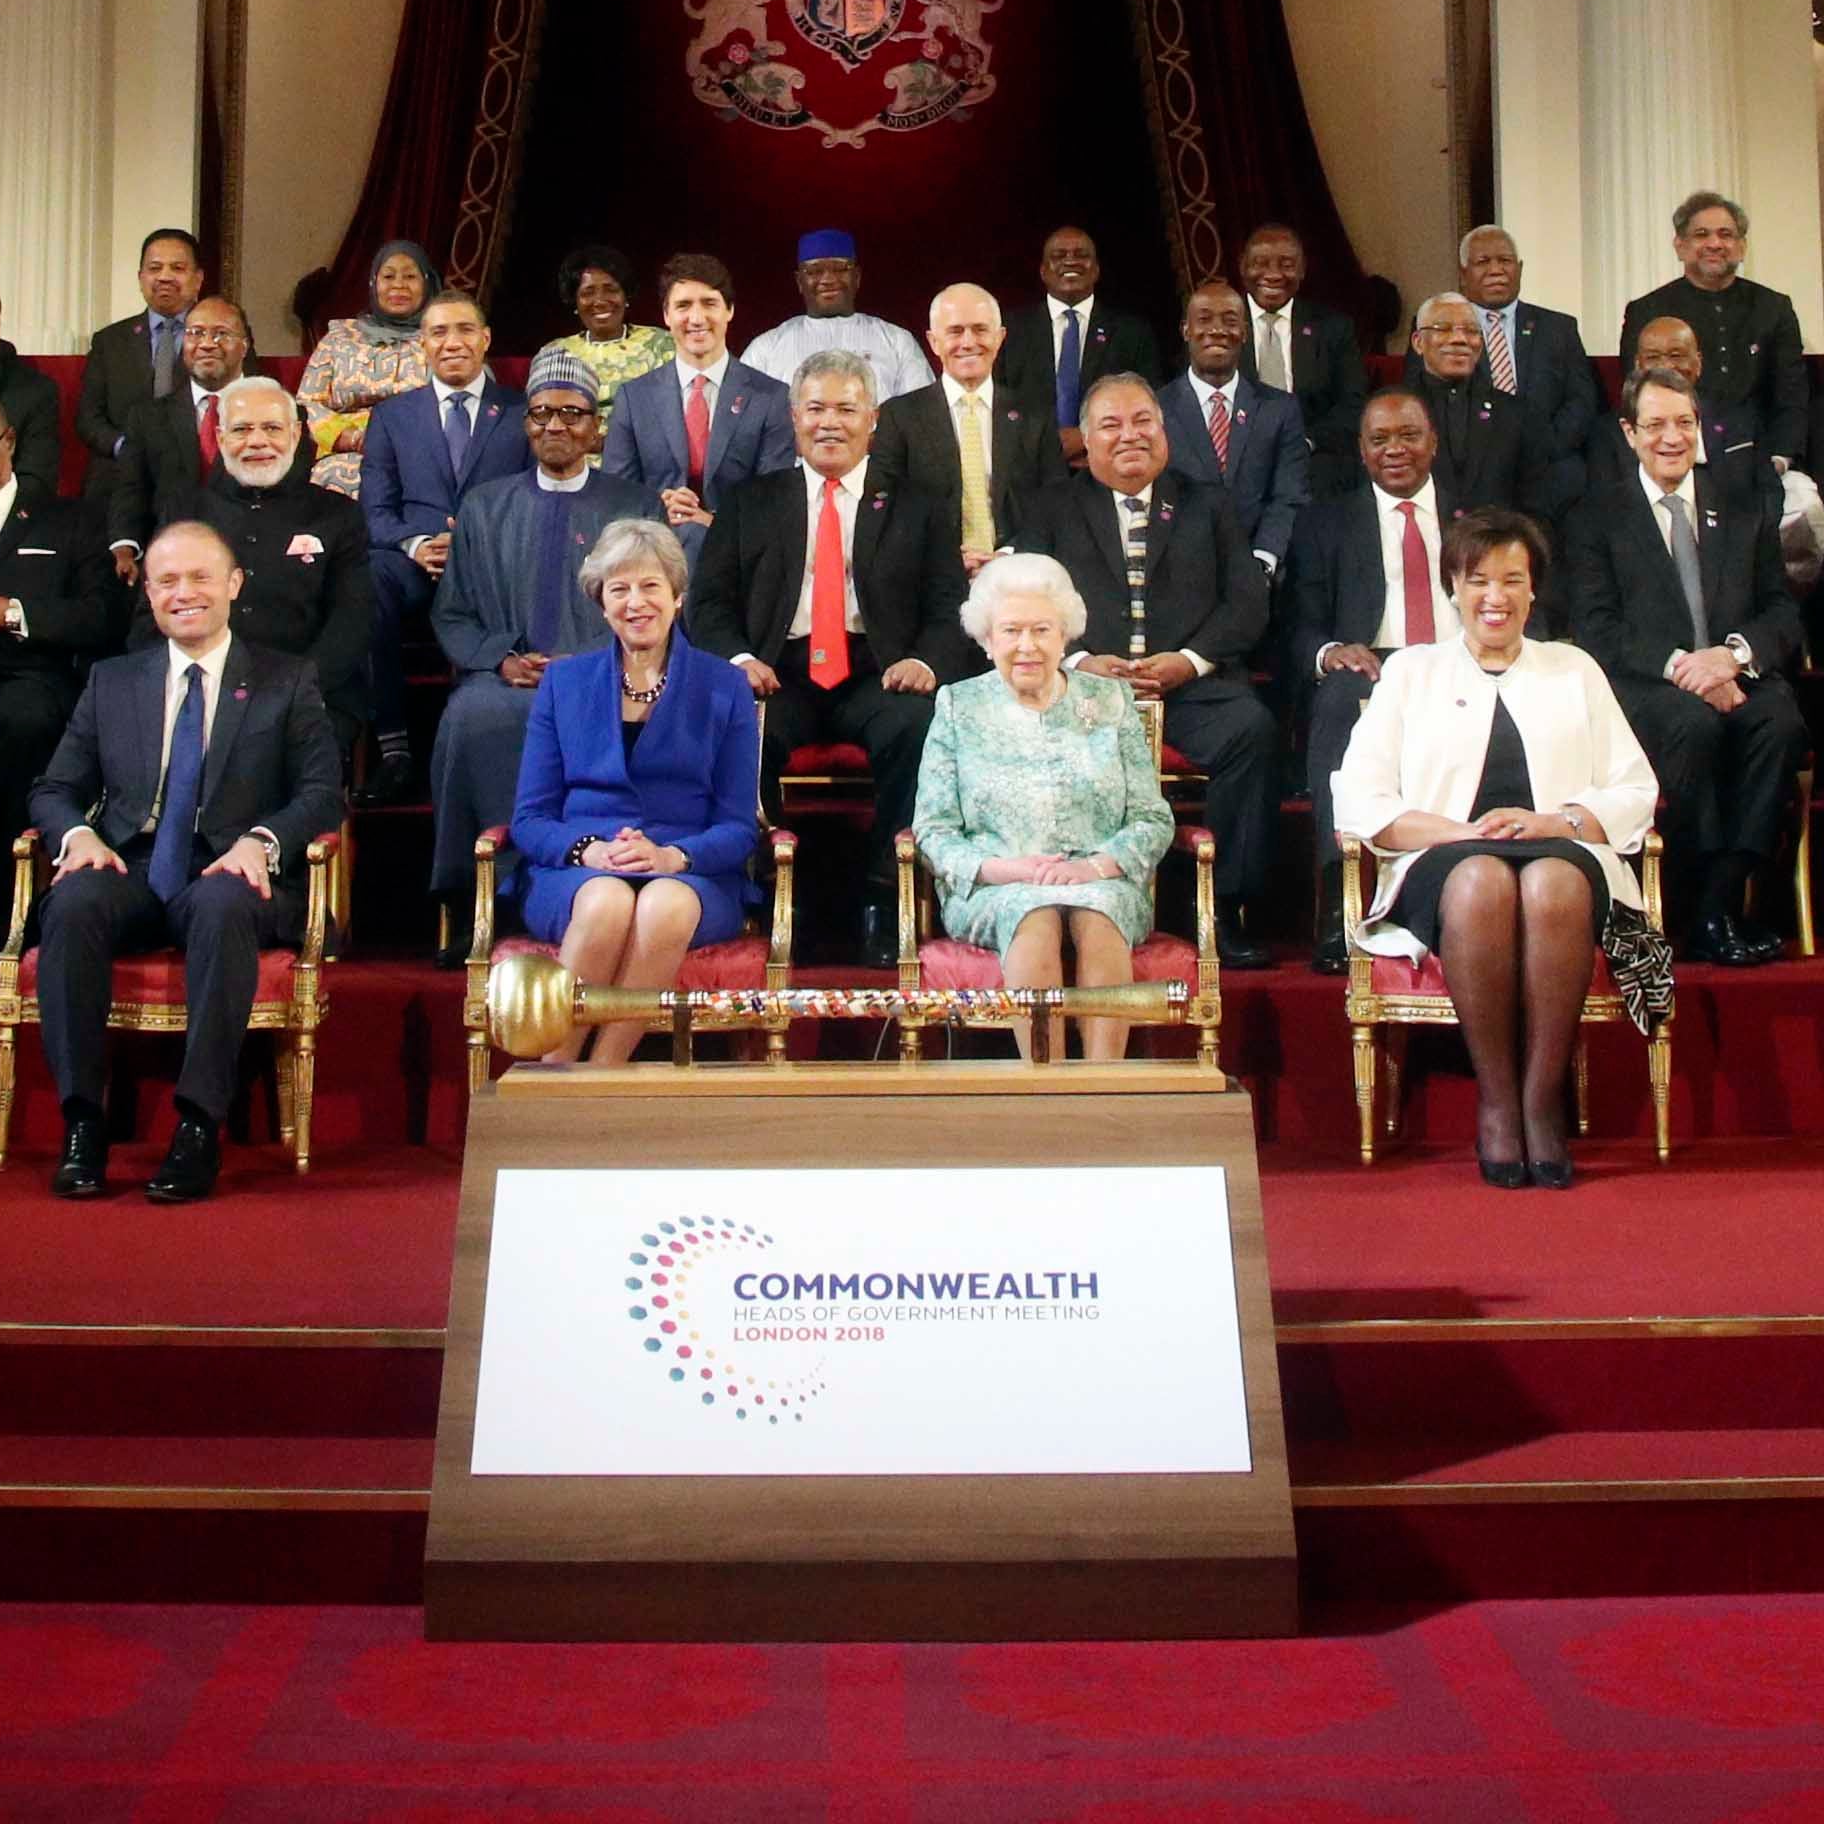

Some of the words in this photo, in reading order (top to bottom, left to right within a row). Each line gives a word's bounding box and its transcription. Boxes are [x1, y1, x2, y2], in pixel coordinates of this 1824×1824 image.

[733, 1272, 1099, 1301] COMMONWEALTH
[733, 1306, 807, 1322] HEADS
[812, 1306, 841, 1322] OF
[847, 1305, 996, 1322] GOVERNMENT
[1004, 1304, 1100, 1321] MEETING
[733, 1327, 828, 1343] LONDON
[834, 1327, 886, 1342] 2018
